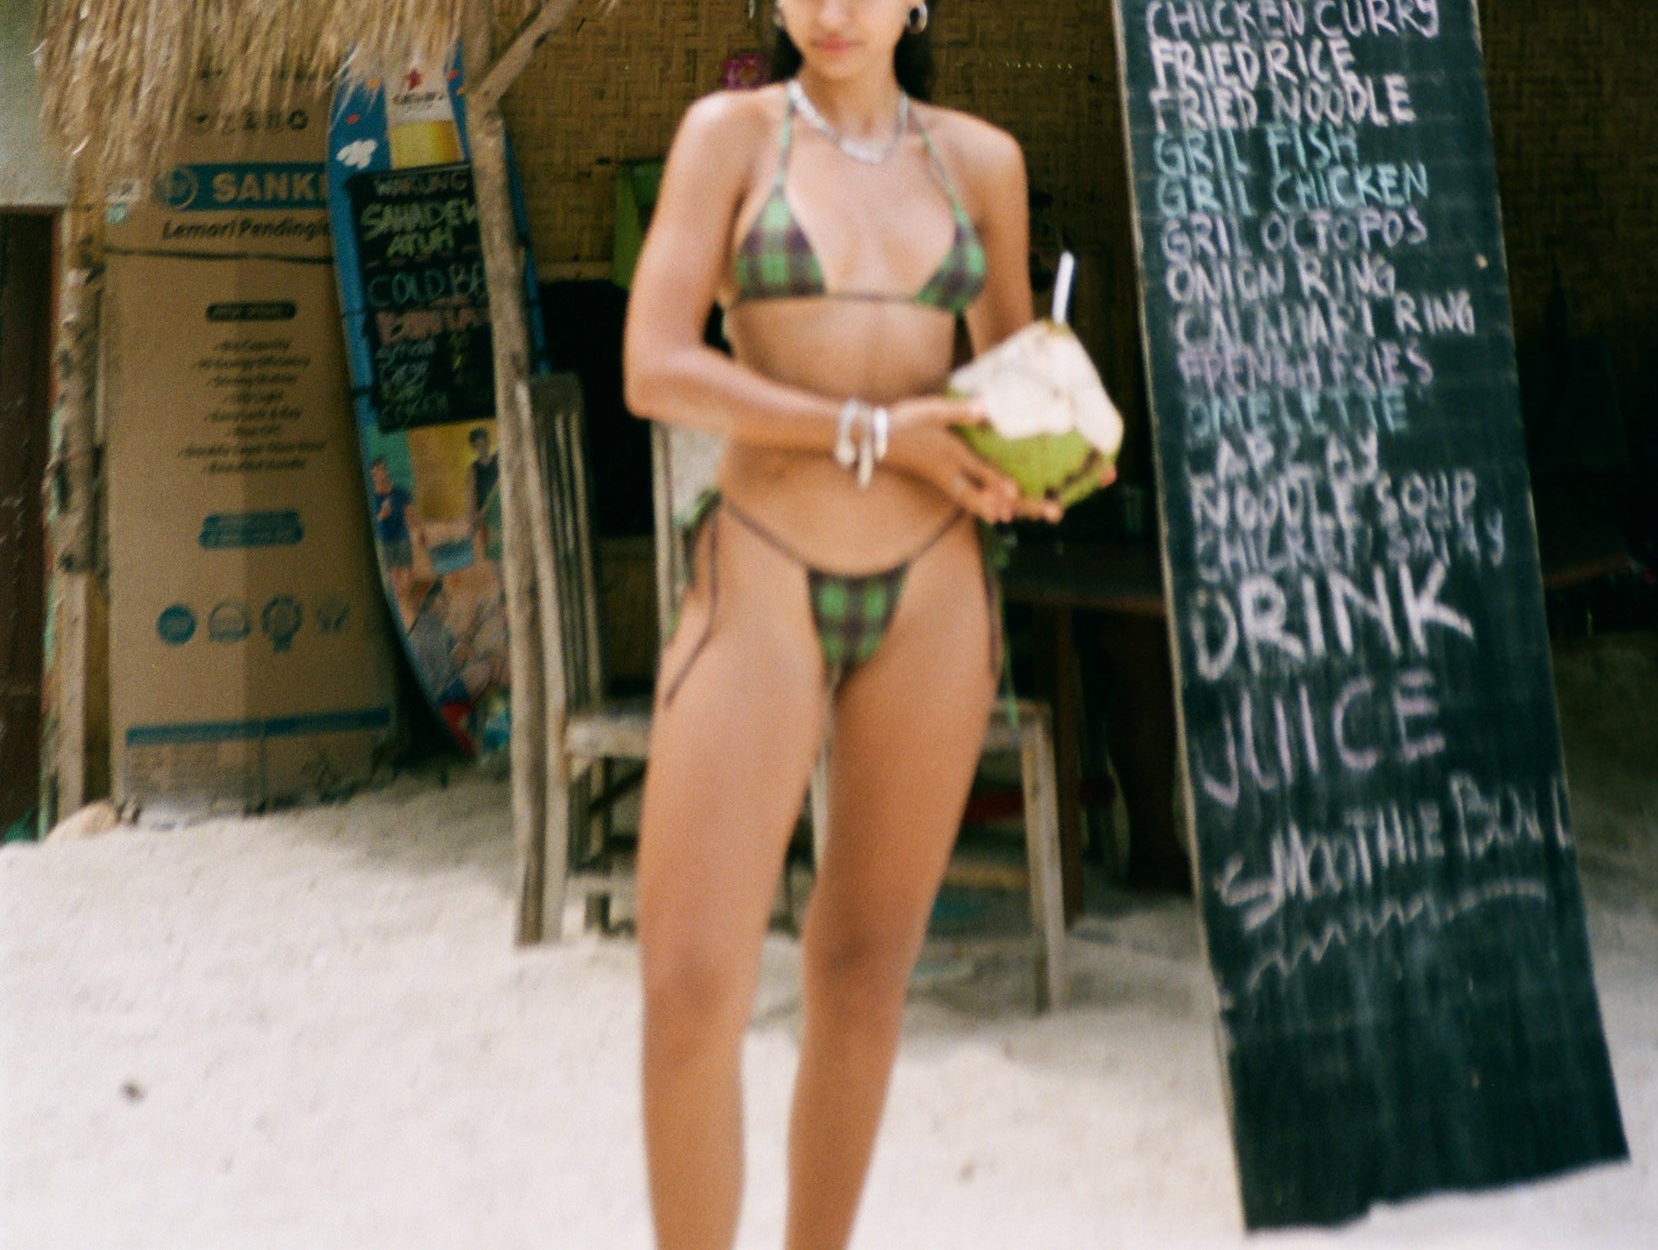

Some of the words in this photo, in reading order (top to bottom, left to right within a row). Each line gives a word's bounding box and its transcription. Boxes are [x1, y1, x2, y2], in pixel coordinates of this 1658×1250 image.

[1150, 37, 1260, 90] FRIED
[1263, 37, 1356, 86] RICE
[1149, 86, 1257, 134] FRIED
[1271, 73, 1417, 128] NOODLE
[1265, 121, 1359, 174] FISH
[1271, 161, 1430, 215] CHICKEN
[1294, 250, 1396, 300] RING
[1394, 289, 1476, 337] RING
[1375, 468, 1477, 528] SOUP
[1191, 558, 1476, 681] DRINK
[1201, 668, 1446, 808] JUICE
